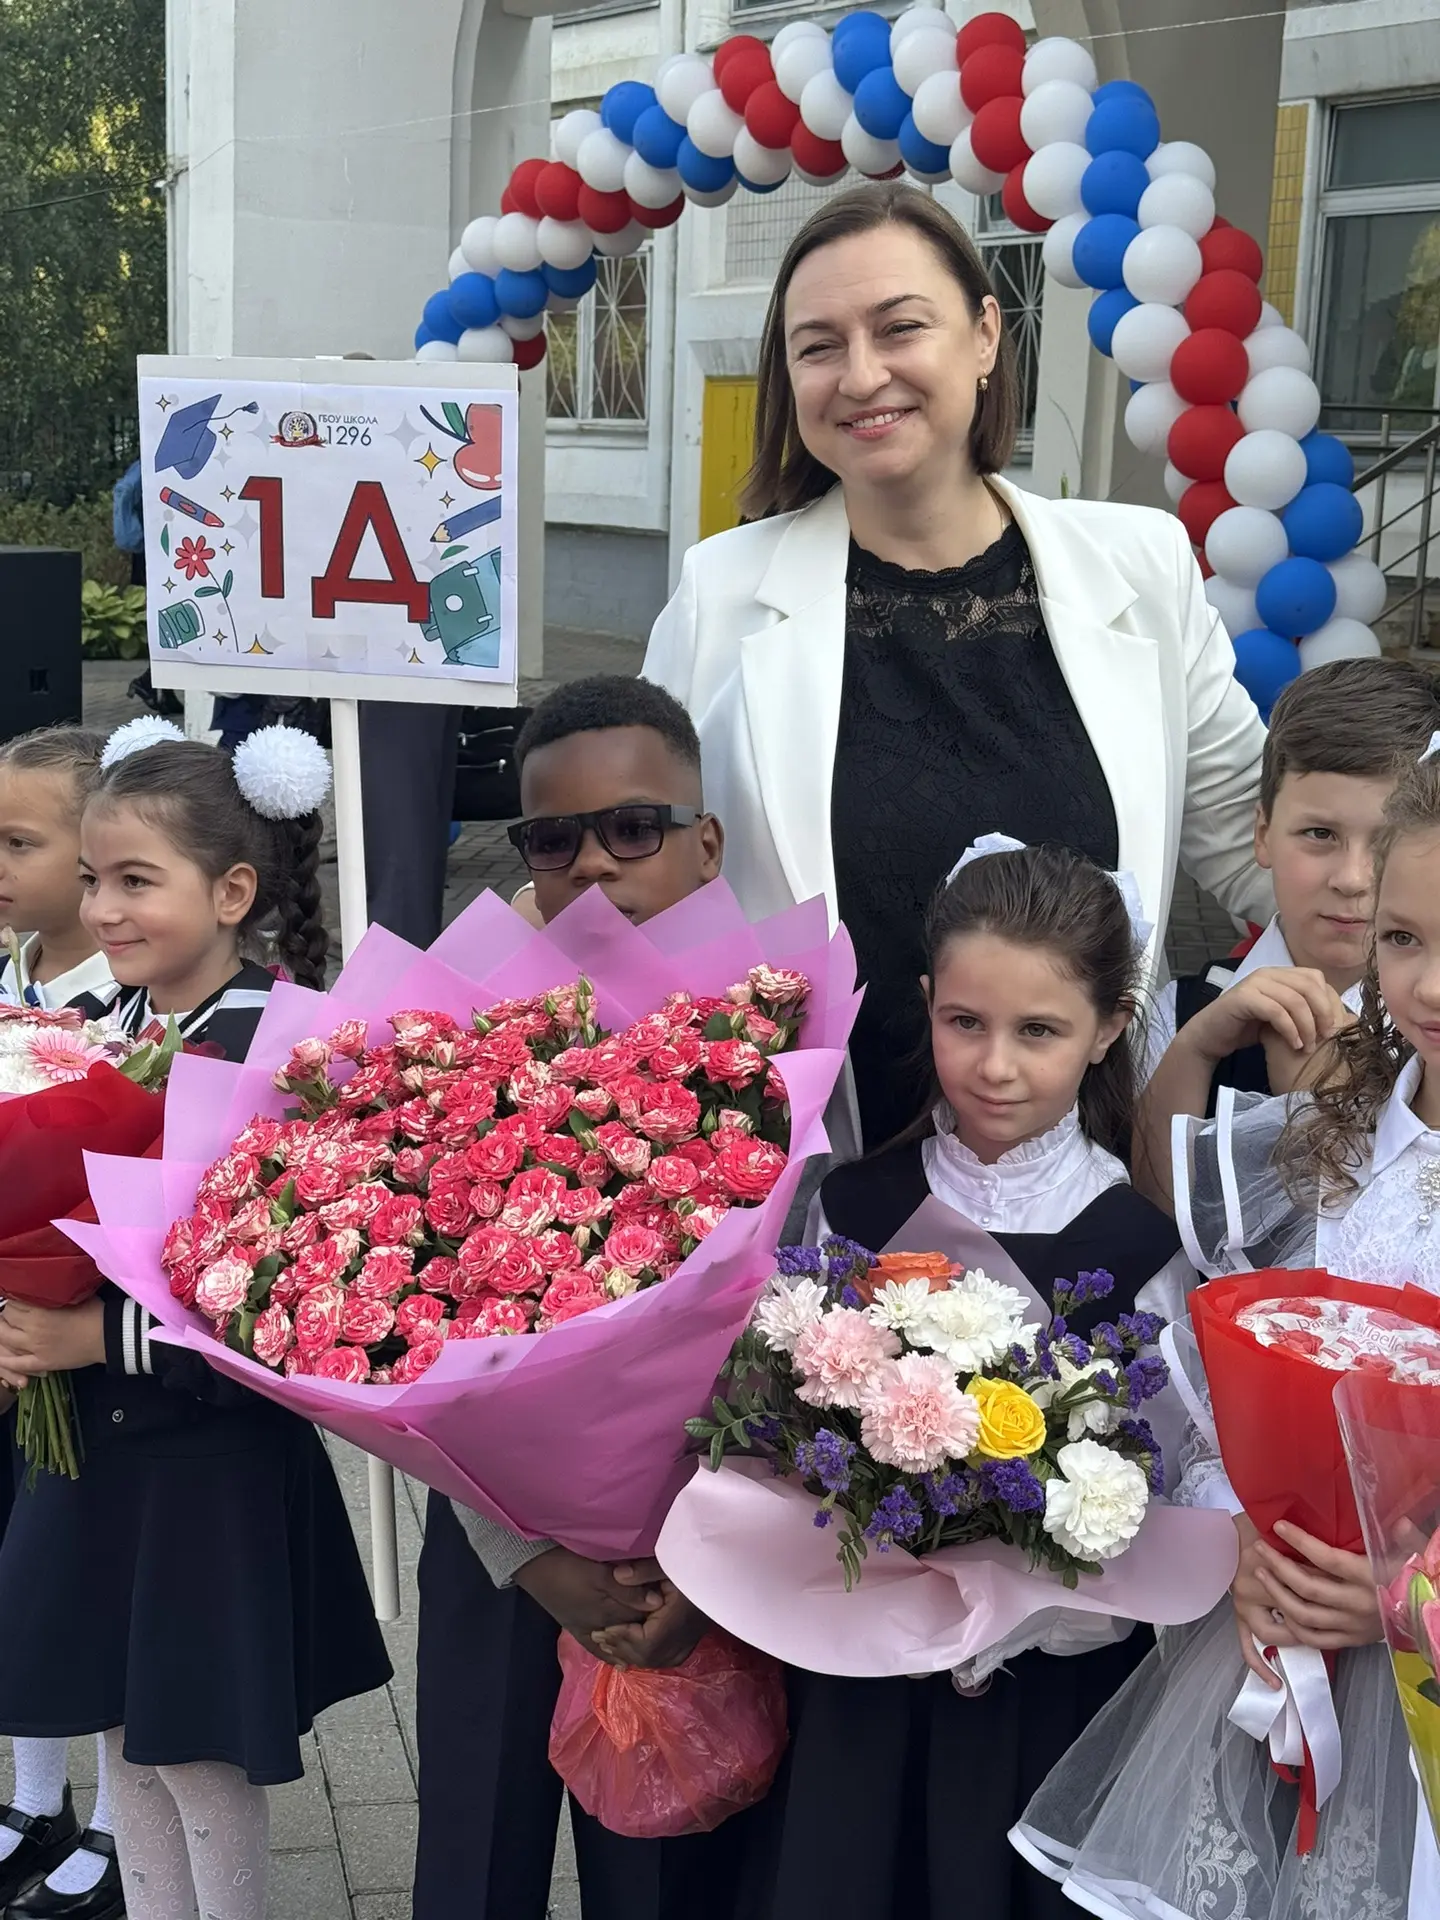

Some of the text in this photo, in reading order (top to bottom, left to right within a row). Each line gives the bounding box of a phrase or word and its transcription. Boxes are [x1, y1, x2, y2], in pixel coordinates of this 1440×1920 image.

[319, 414, 379, 425] ГБОУ ШКОЛА
[327, 426, 372, 446] 1296
